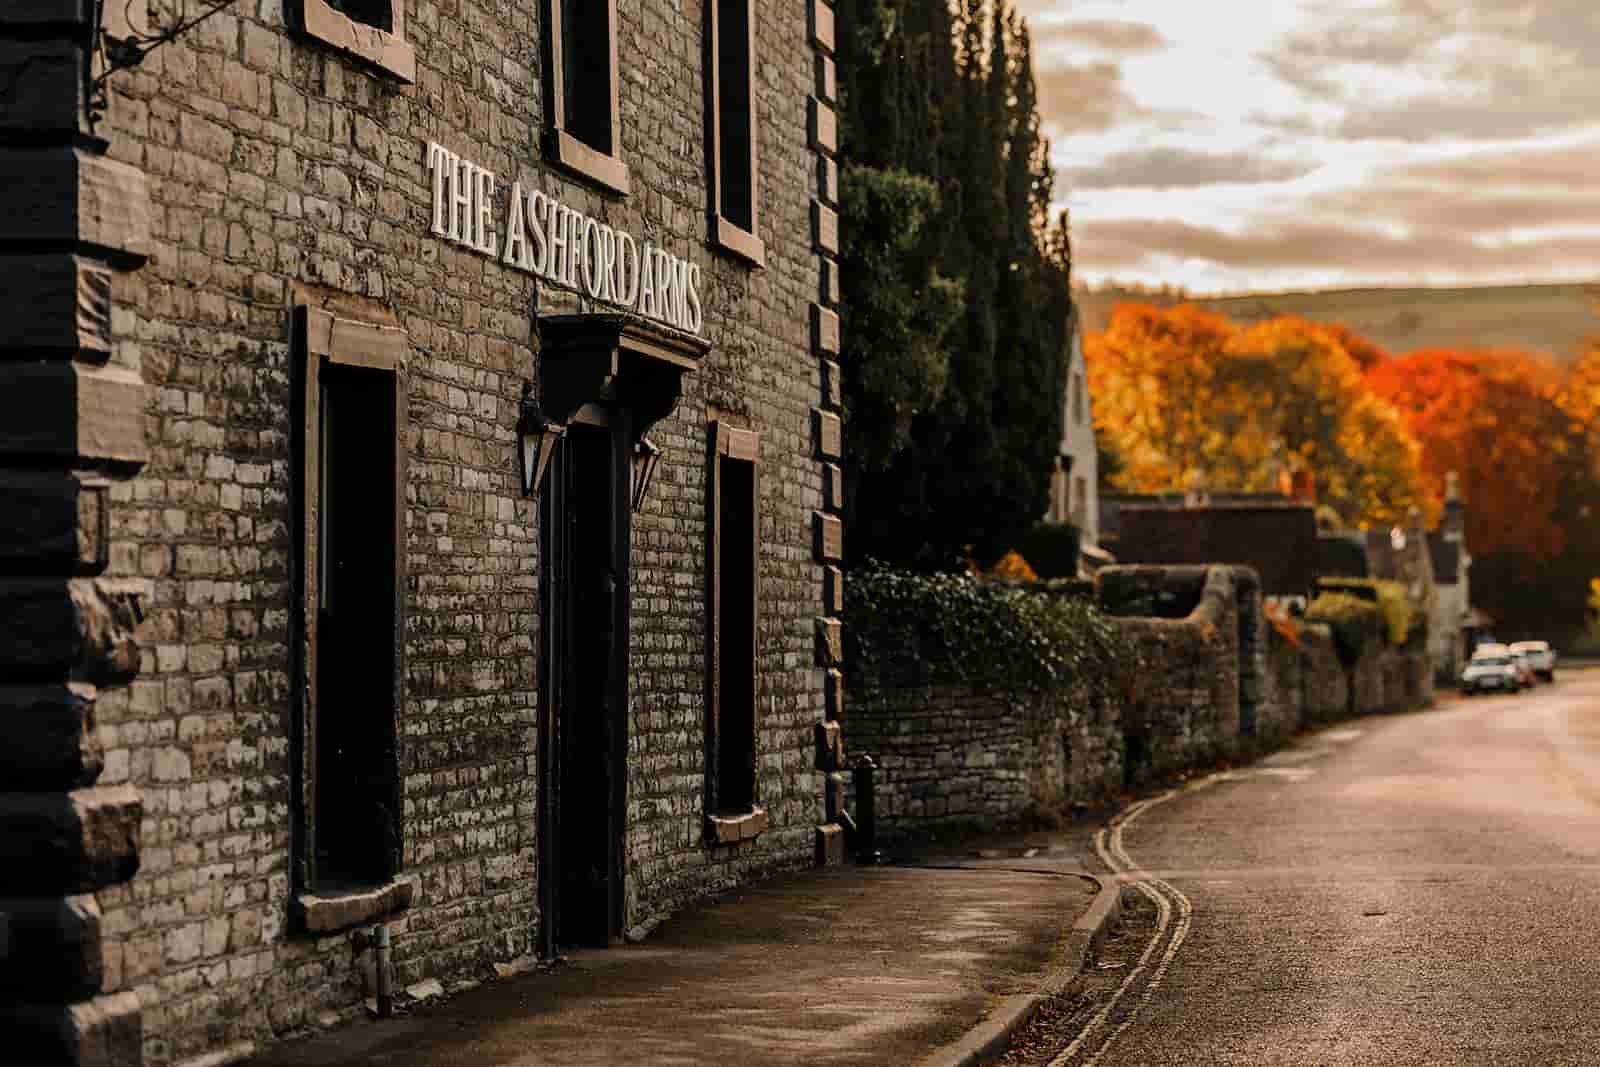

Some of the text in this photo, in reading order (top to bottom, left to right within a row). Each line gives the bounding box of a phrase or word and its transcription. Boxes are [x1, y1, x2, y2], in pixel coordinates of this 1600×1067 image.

[427, 142, 702, 334] THE ASHFORD ARMS
